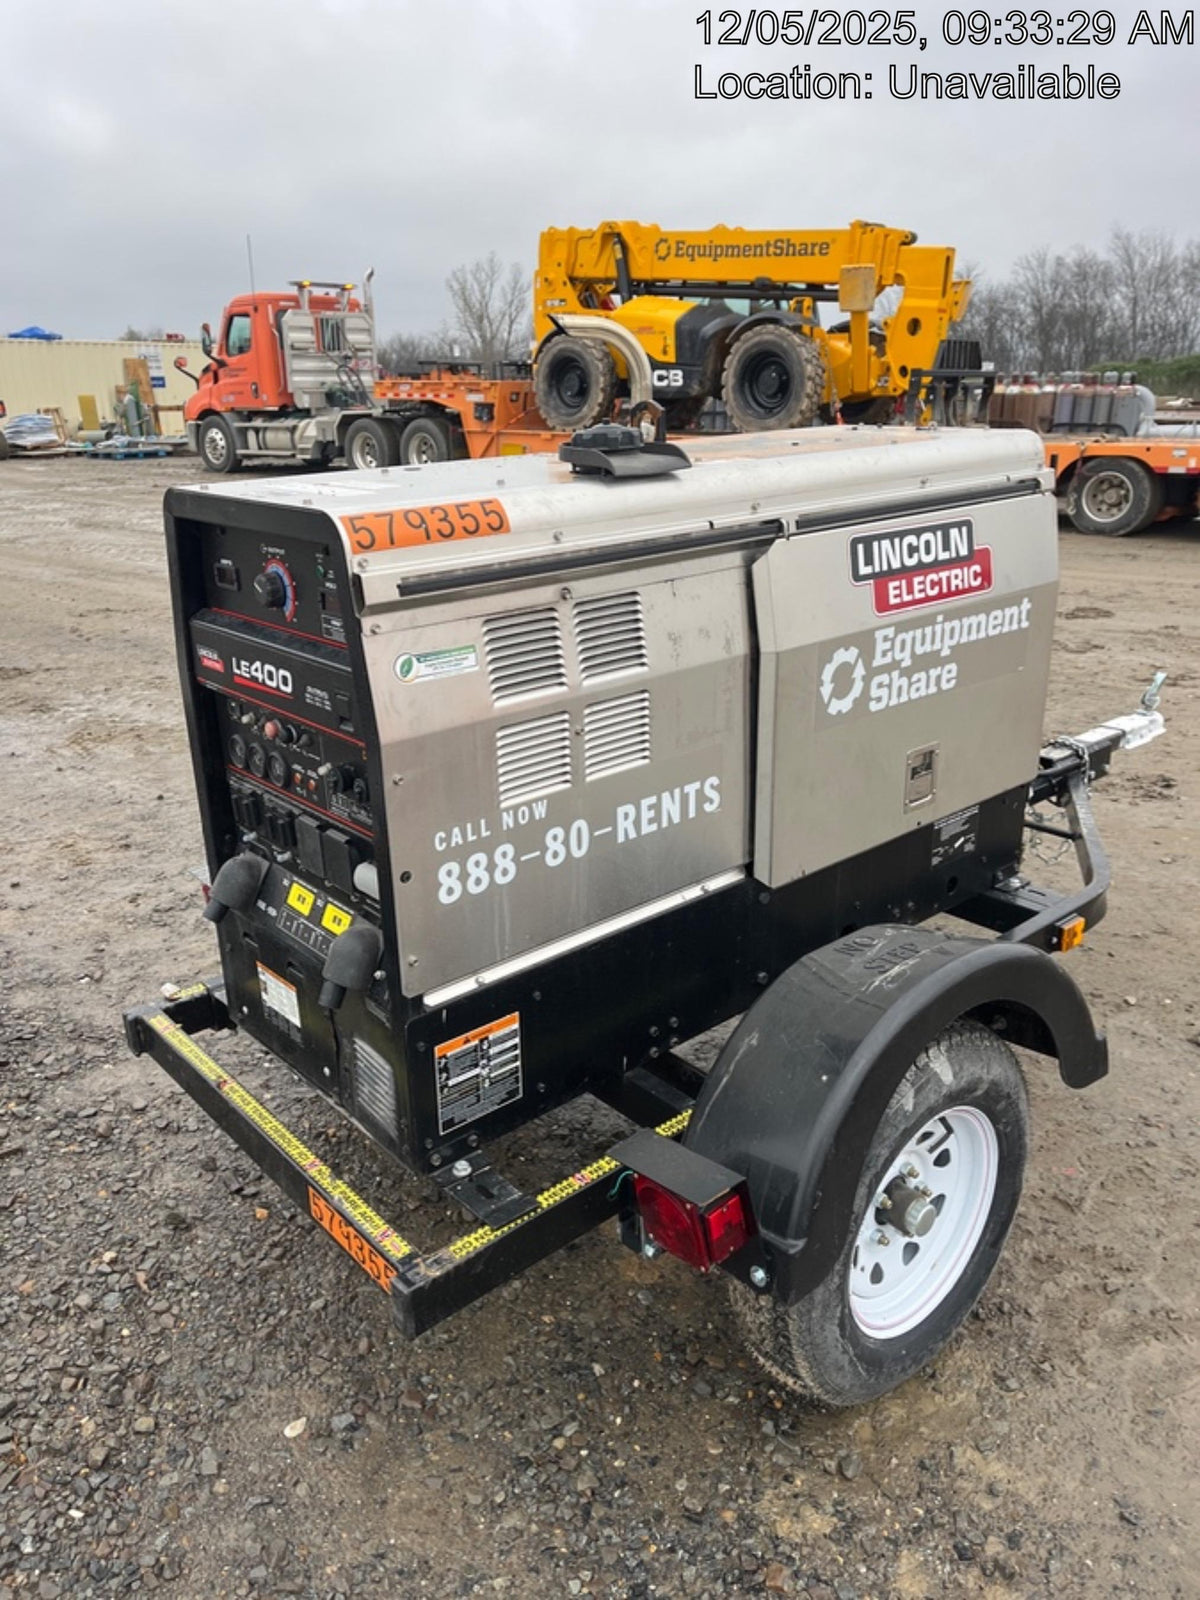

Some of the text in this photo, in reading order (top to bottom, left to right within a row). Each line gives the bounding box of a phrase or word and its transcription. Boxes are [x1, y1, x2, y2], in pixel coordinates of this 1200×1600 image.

[674, 237, 831, 262] EquipmentShare
[652, 368, 684, 387] CB
[348, 500, 504, 550] 579355
[856, 525, 969, 576] LINCOLN
[887, 564, 982, 606] ELECTRIC
[871, 597, 1032, 668] Equipment
[232, 656, 292, 694] LE400
[868, 662, 958, 712] Share
[434, 799, 548, 851] CALL NOW
[437, 775, 721, 904] 888-80-RENTS
